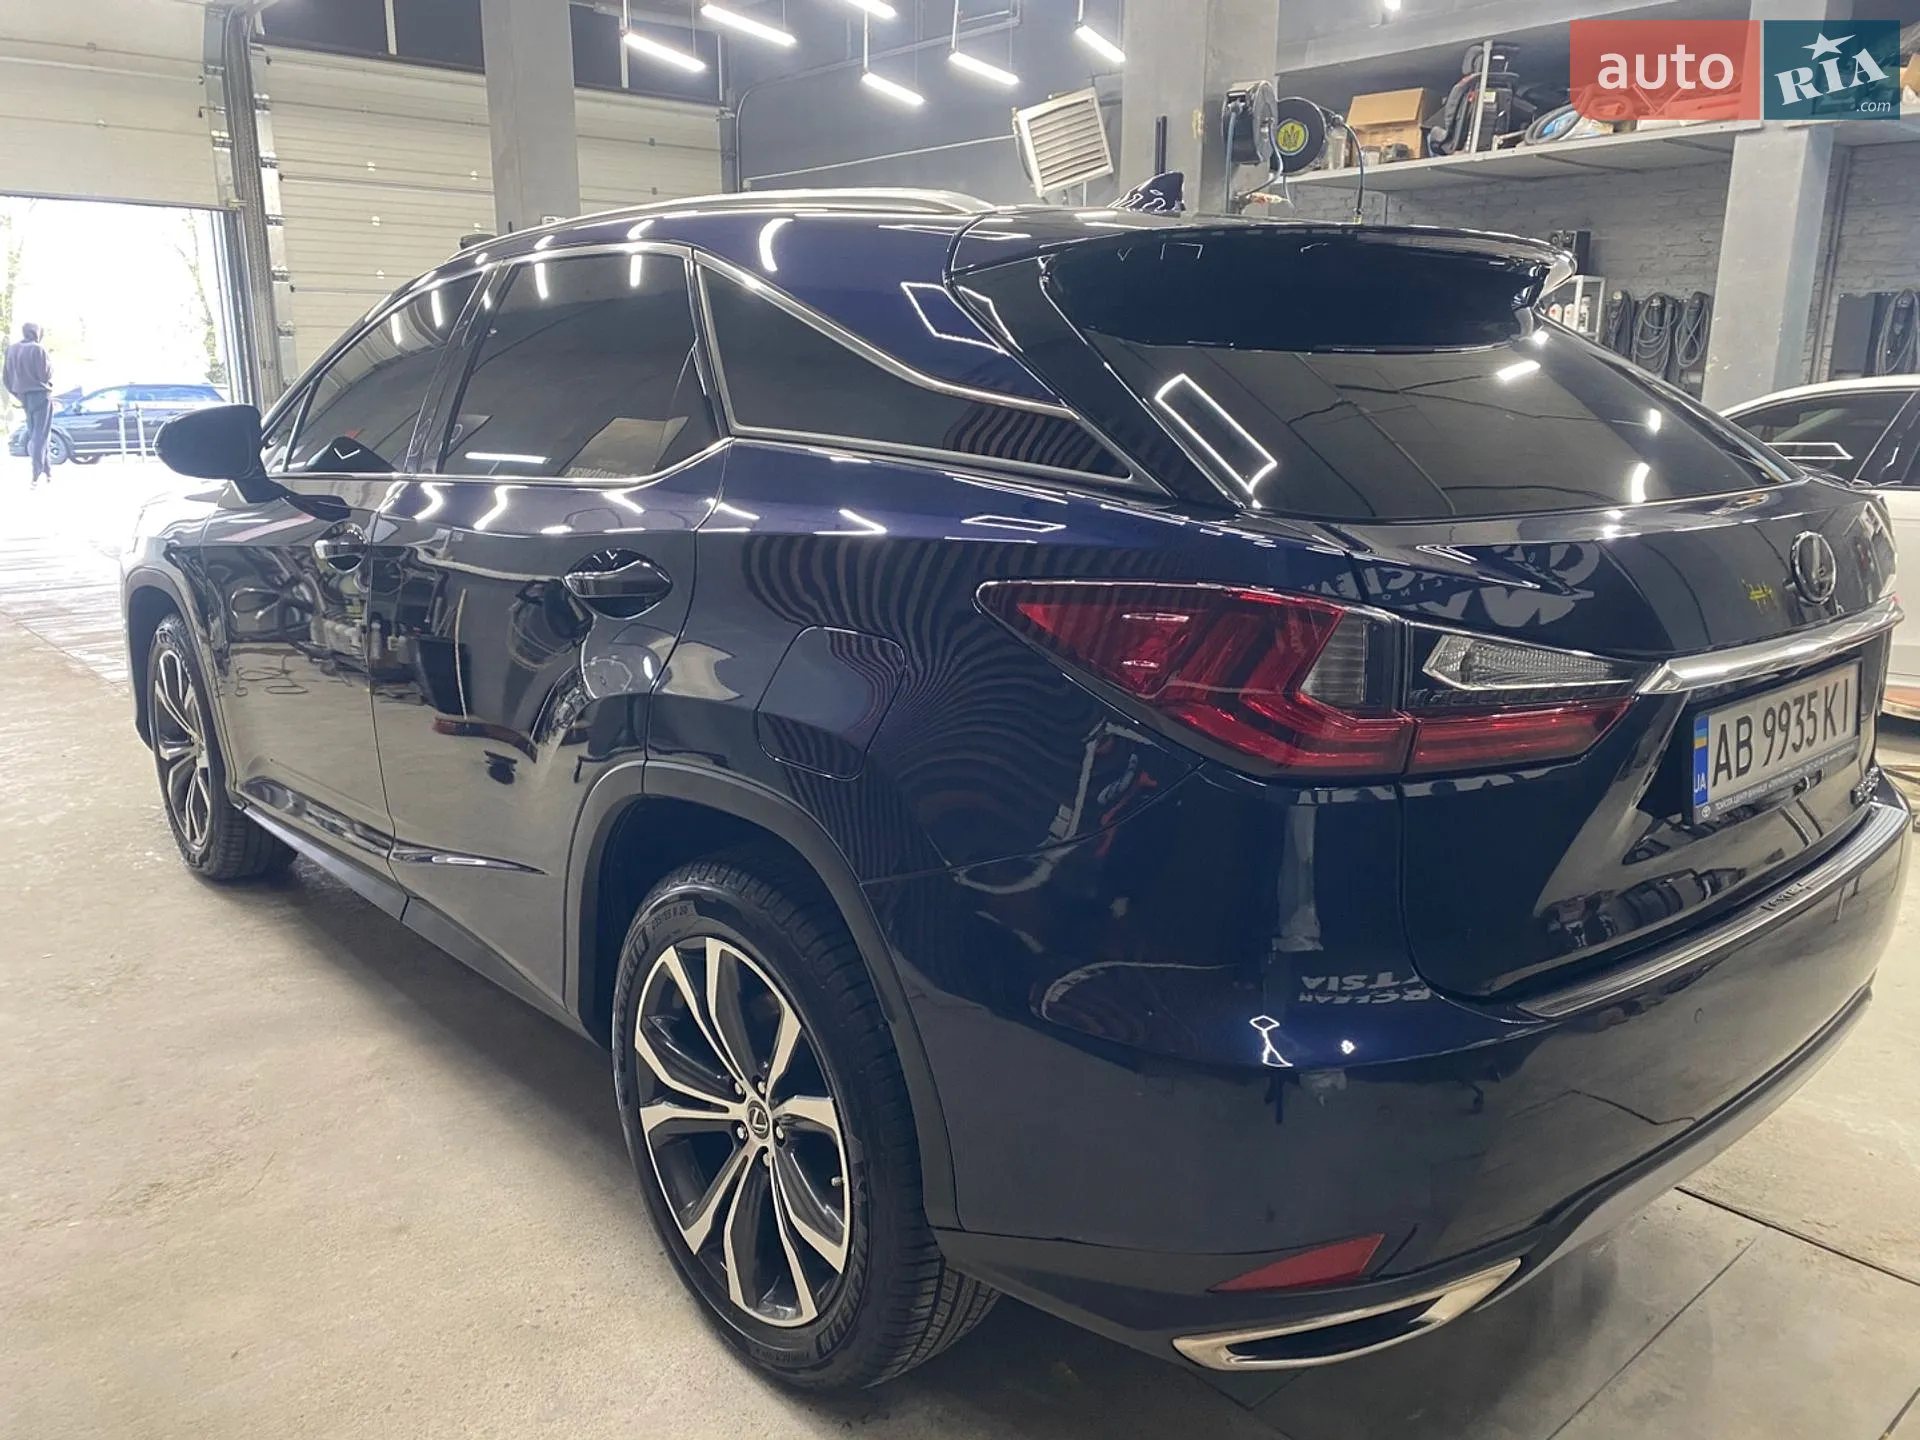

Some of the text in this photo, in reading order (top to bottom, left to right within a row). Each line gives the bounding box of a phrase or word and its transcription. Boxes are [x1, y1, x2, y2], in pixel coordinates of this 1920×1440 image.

[1711, 716, 1753, 787] AB
[1762, 690, 1819, 768] 9935
[1823, 679, 1849, 741] KI
